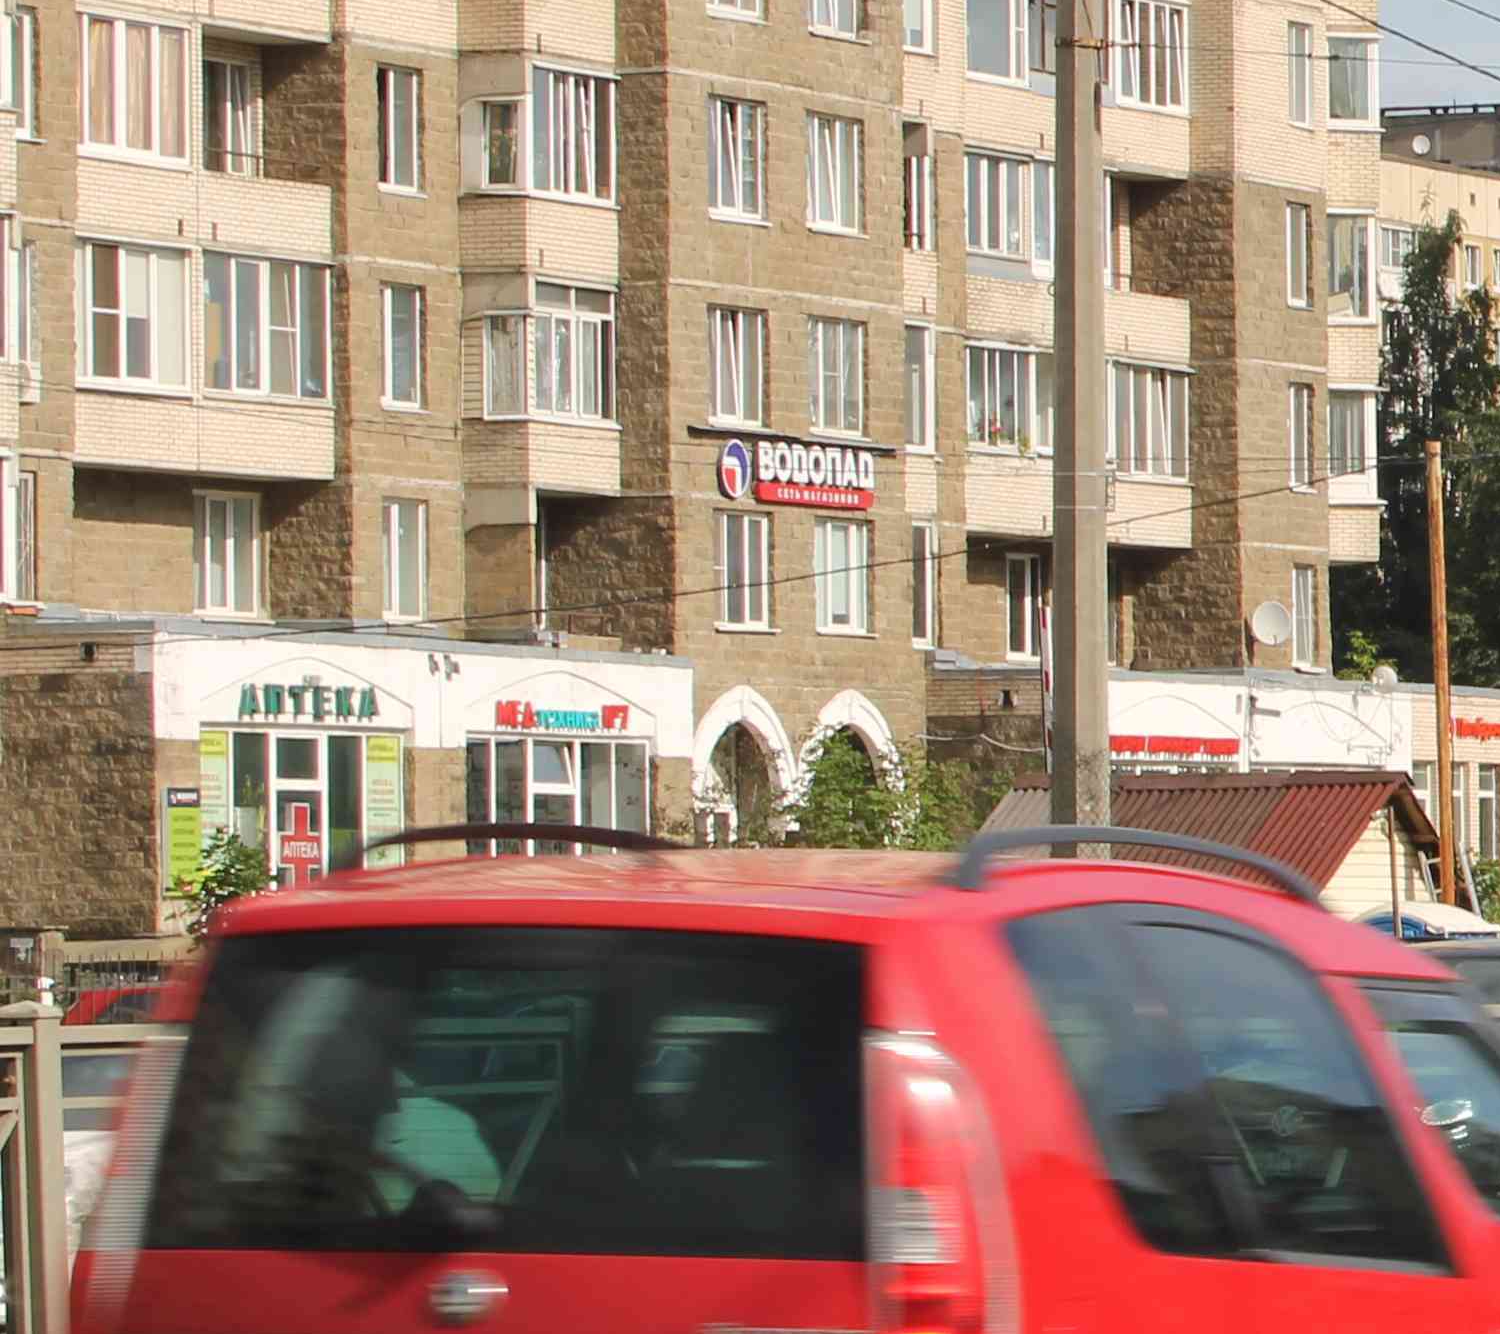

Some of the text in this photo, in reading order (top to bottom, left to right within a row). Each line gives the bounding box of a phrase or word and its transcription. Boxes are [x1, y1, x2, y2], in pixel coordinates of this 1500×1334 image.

[757, 441, 875, 489] ВОДОПАД
[776, 488, 801, 501] СЕТЬ
[238, 682, 379, 722] АПТЕКА
[282, 841, 320, 858] АПТЕКА
